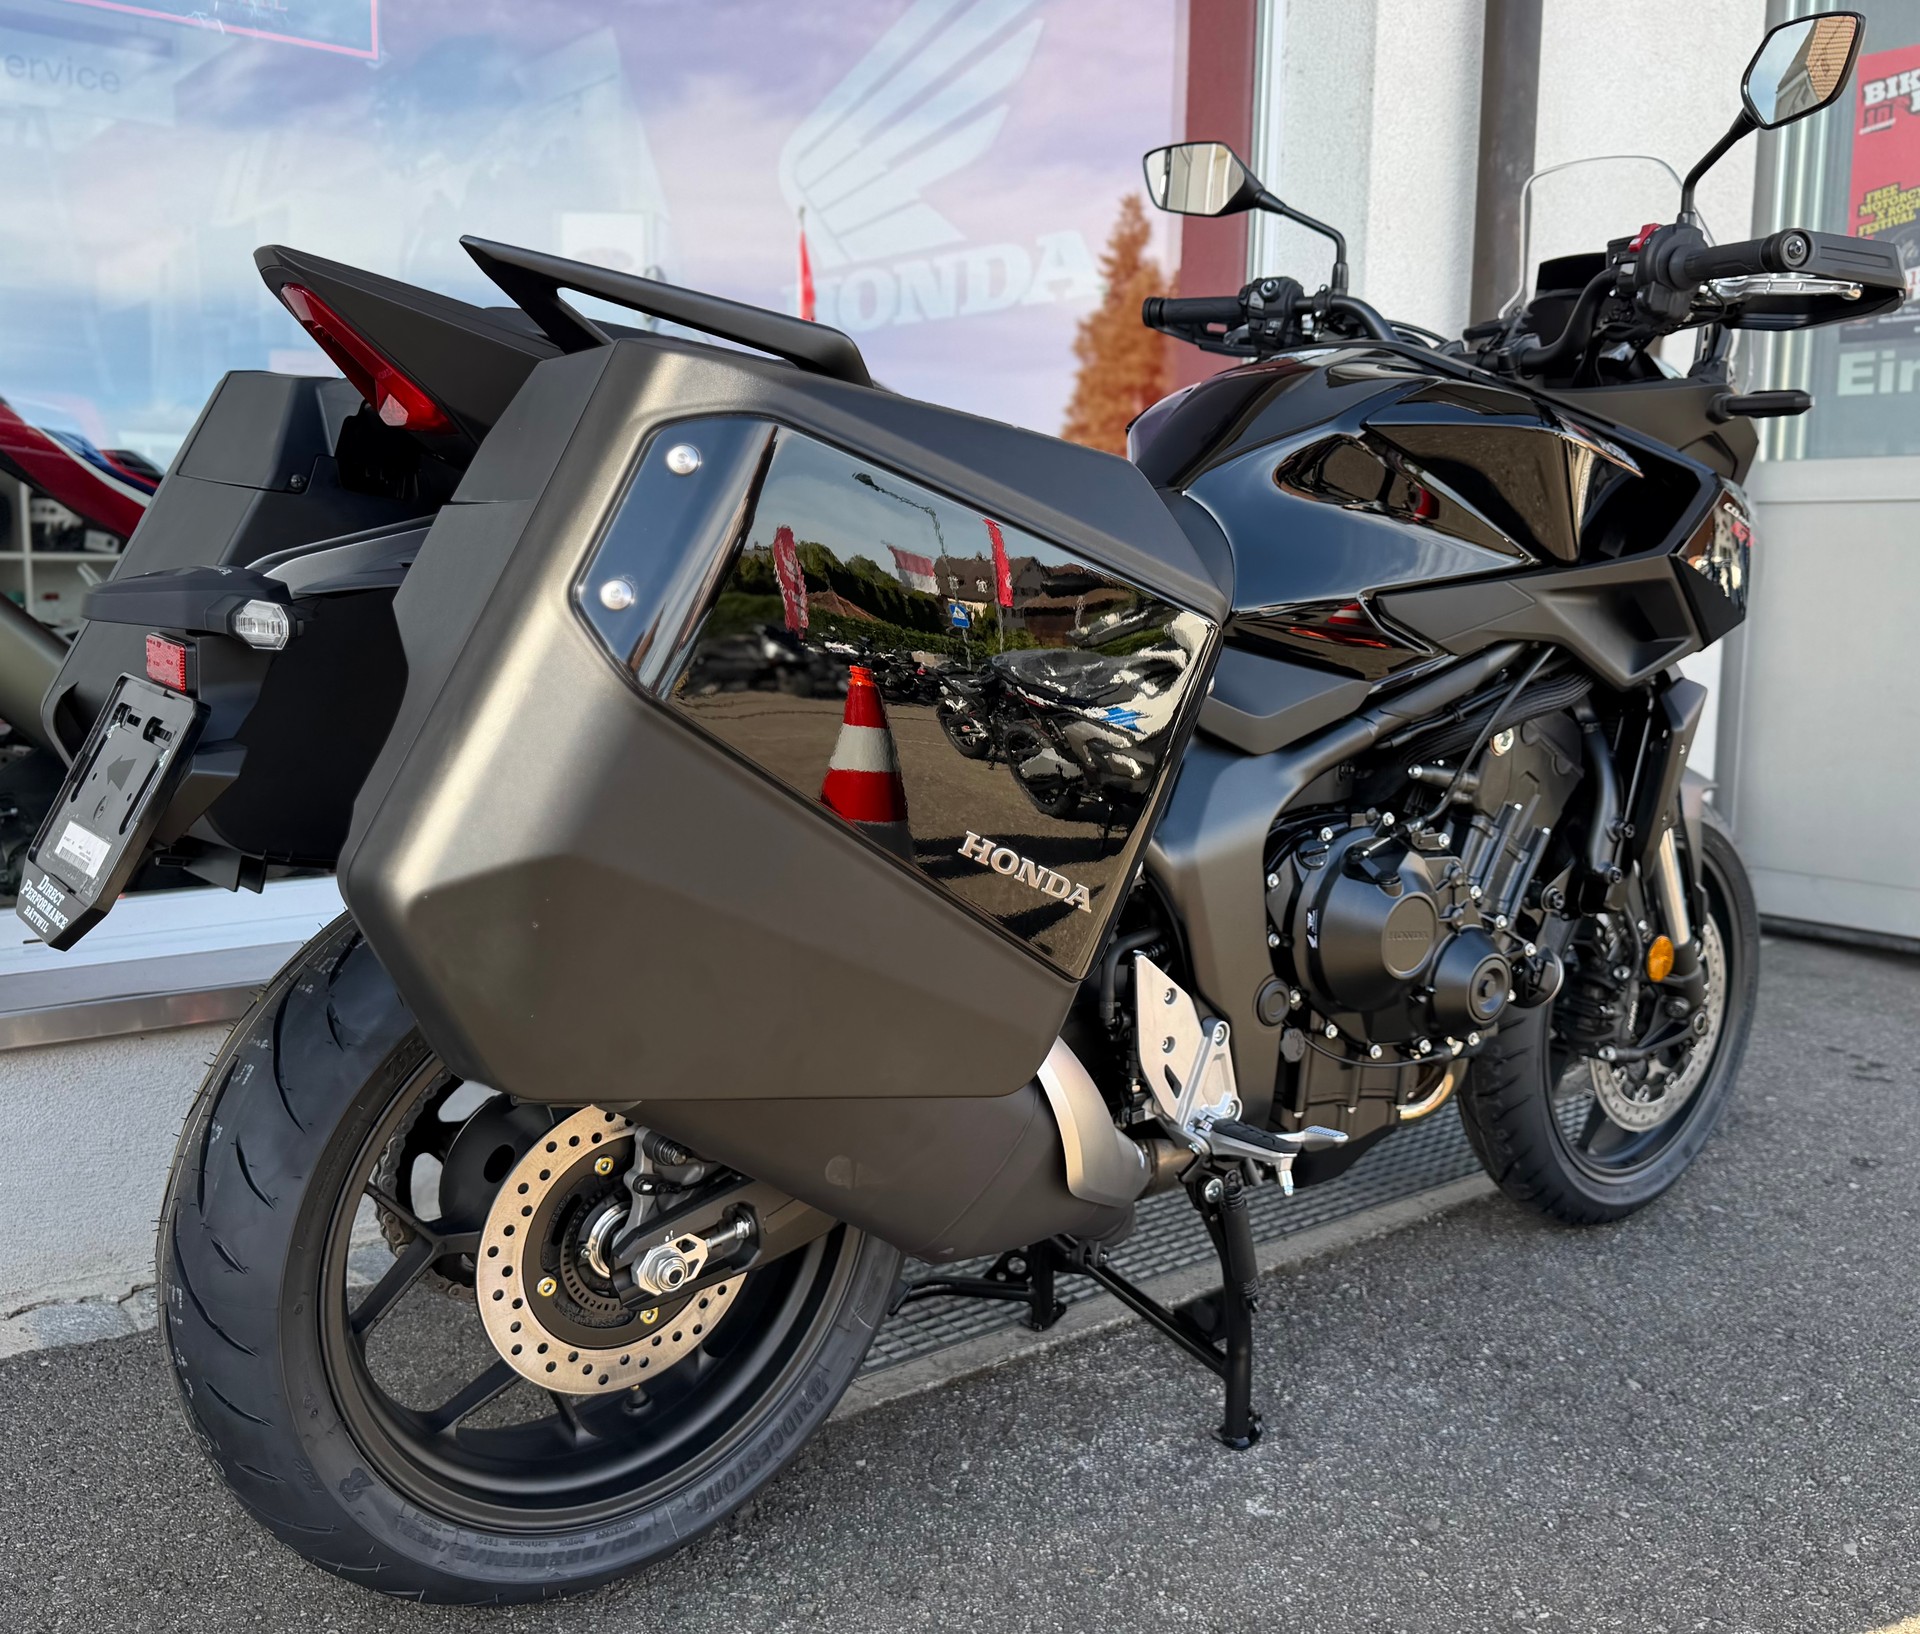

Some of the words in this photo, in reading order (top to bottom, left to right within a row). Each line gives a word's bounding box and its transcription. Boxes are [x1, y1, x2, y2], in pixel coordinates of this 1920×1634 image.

[4, 53, 121, 95] ervice
[1864, 69, 1920, 106] BIK
[36, 874, 66, 907] DIRECT
[957, 830, 1092, 914] HONDA
[20, 878, 69, 930] PERFORMANCE
